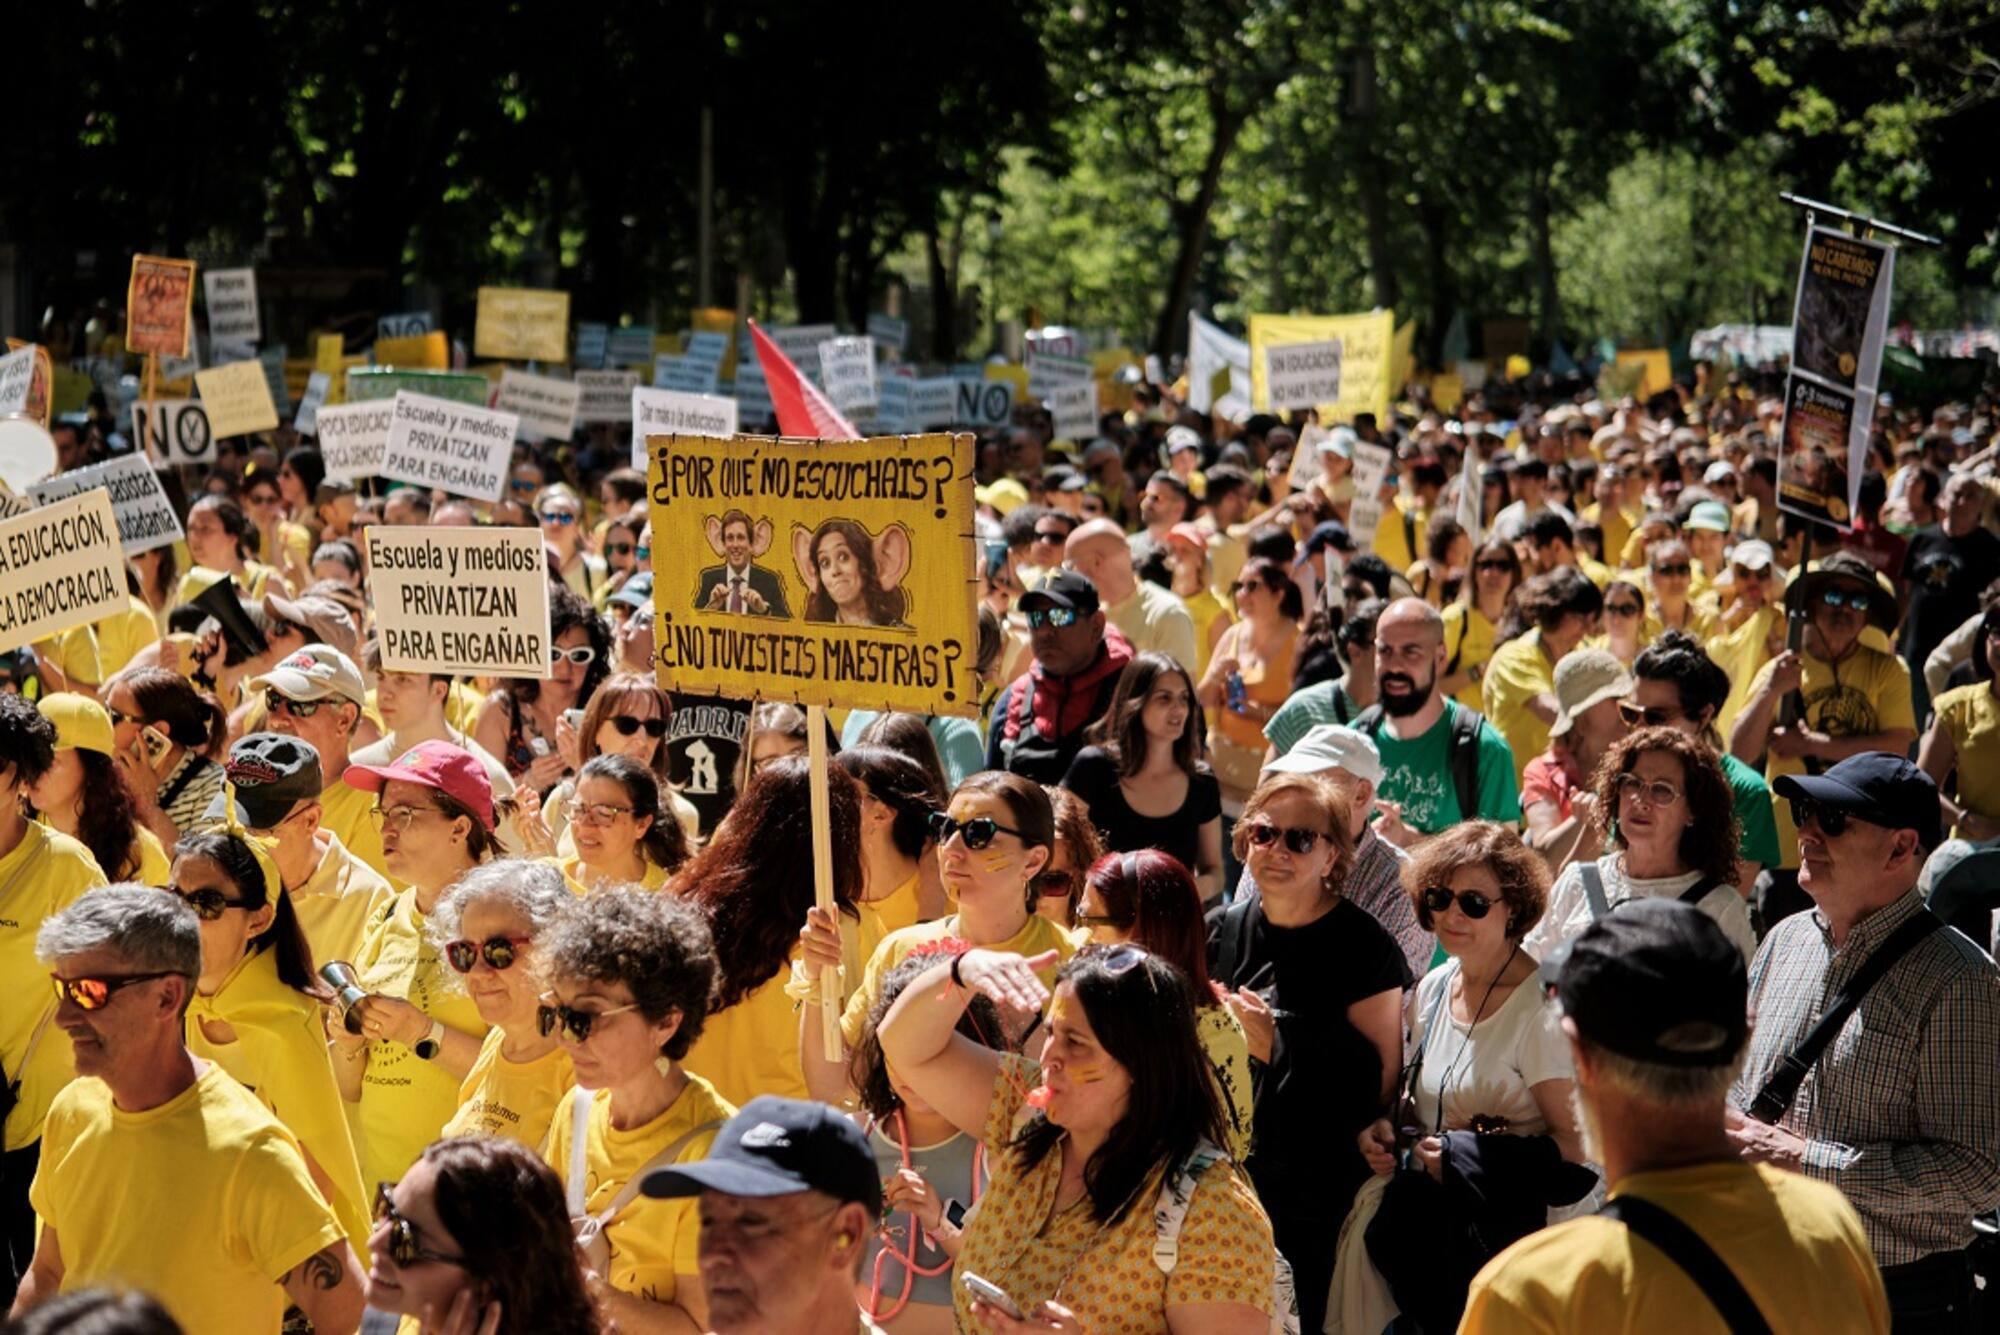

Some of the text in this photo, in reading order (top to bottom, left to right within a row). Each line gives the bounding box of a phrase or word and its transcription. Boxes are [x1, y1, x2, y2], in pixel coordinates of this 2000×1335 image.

[396, 399, 512, 441] Escuela y medios:
[957, 381, 1010, 421] NO
[137, 404, 211, 457] NO
[407, 429, 491, 464] PRIVATIZAN
[102, 469, 159, 504] lasistas
[386, 453, 499, 493] PARA ENGAÑAR
[653, 447, 715, 504] ¿POR
[719, 449, 760, 500] QUÉ
[760, 457, 790, 498] NO
[8, 504, 111, 569] EDUCACIÓN,
[370, 538, 541, 578] Escuela y medios:
[17, 566, 120, 626] DEMOCRACIA.
[386, 626, 541, 665] PARA ENGAÑAR
[661, 612, 705, 671] ¿NO
[708, 627, 816, 681] TUVISTEIS
